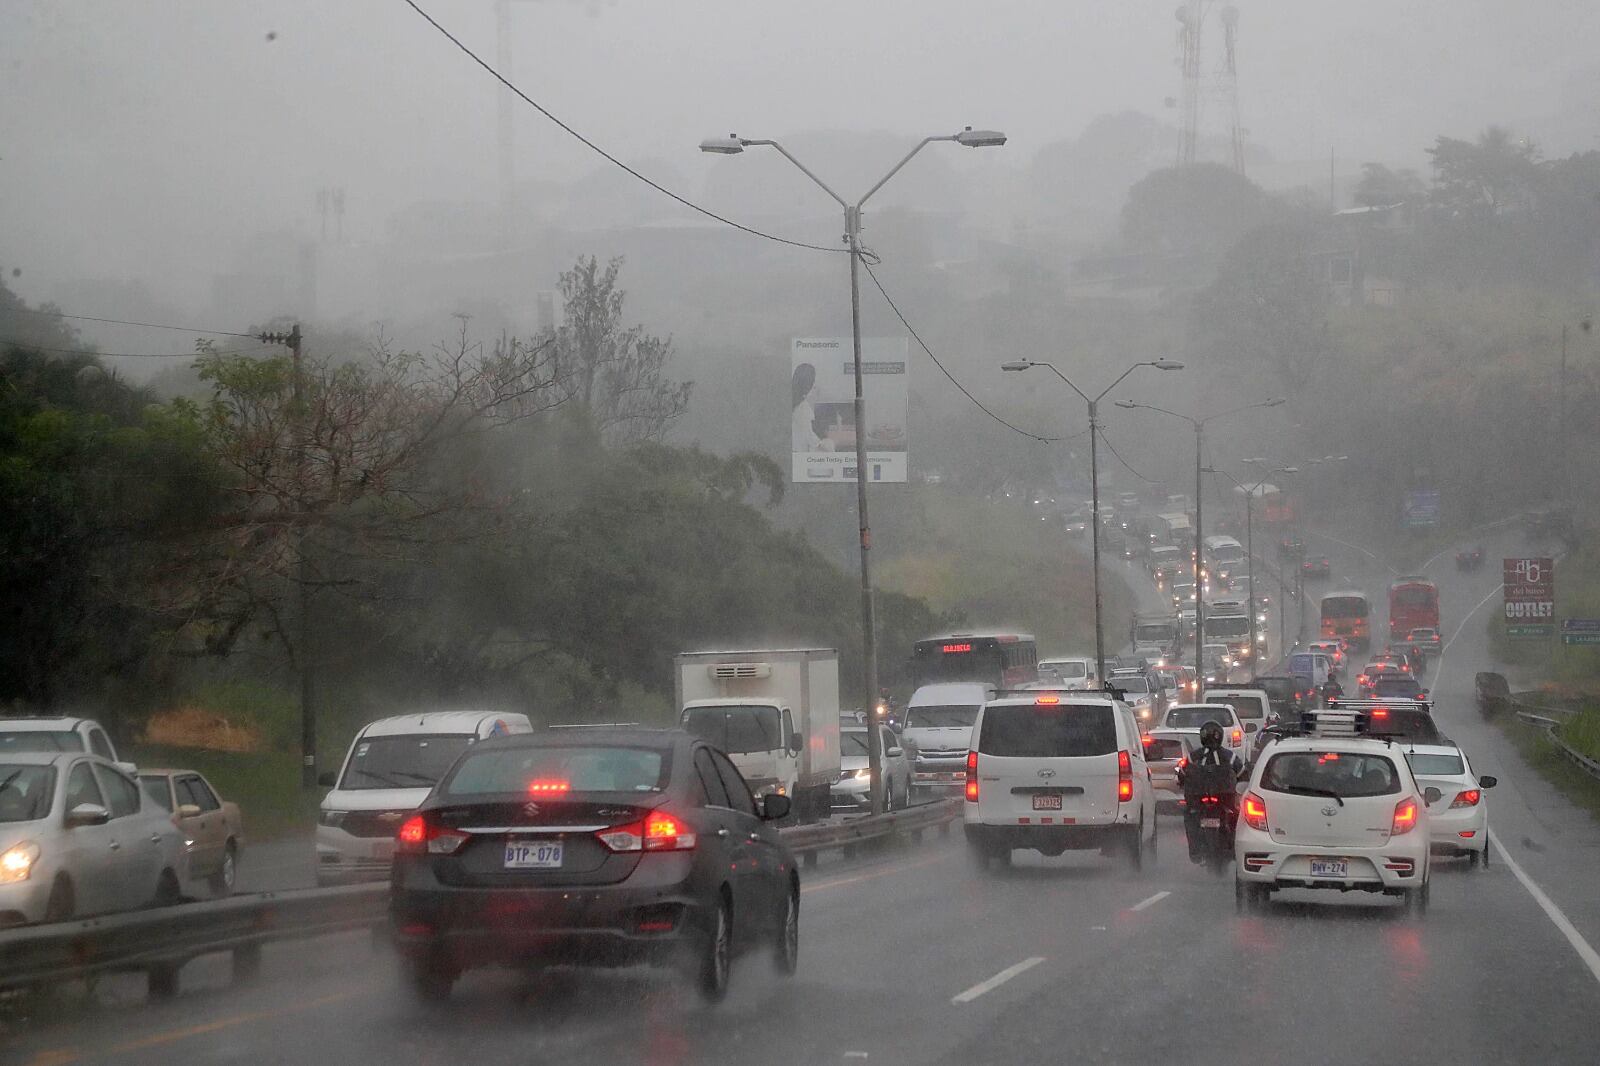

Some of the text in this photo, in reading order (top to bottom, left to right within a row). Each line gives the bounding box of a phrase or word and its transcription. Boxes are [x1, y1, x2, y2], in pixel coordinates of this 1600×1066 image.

[796, 341, 840, 349] Panasonic
[1505, 602, 1553, 618] OUTLET
[507, 847, 560, 861] BTP-078
